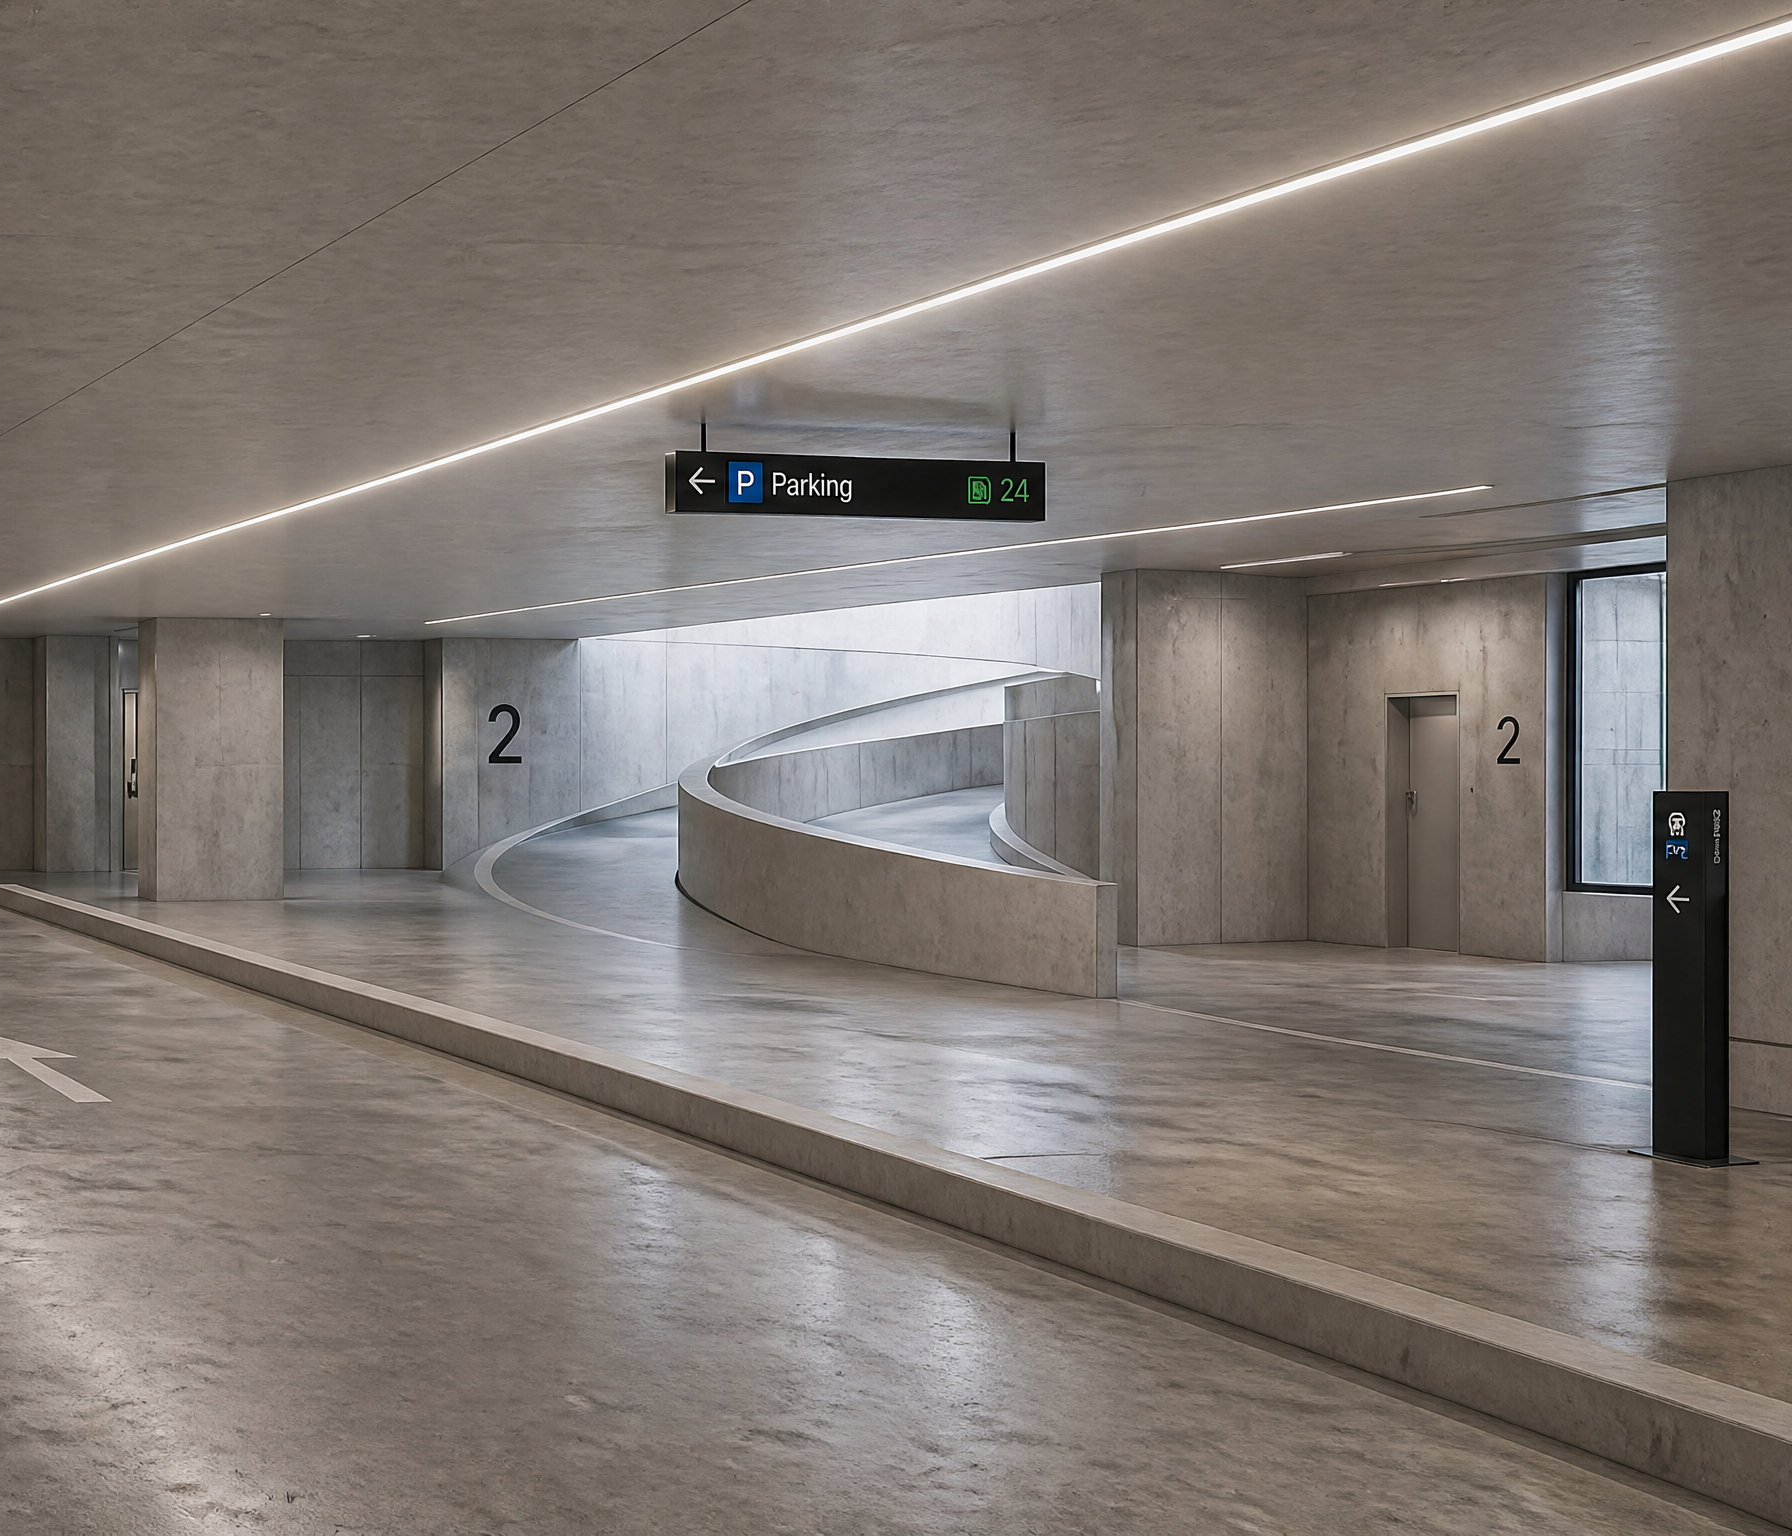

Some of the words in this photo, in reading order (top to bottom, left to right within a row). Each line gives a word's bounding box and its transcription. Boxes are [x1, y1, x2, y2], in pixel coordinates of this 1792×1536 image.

[737, 470, 755, 495] P
[772, 471, 853, 503] Parking
[1000, 477, 1030, 503] 24
[488, 703, 523, 764] 2
[1496, 715, 1521, 765] 2
